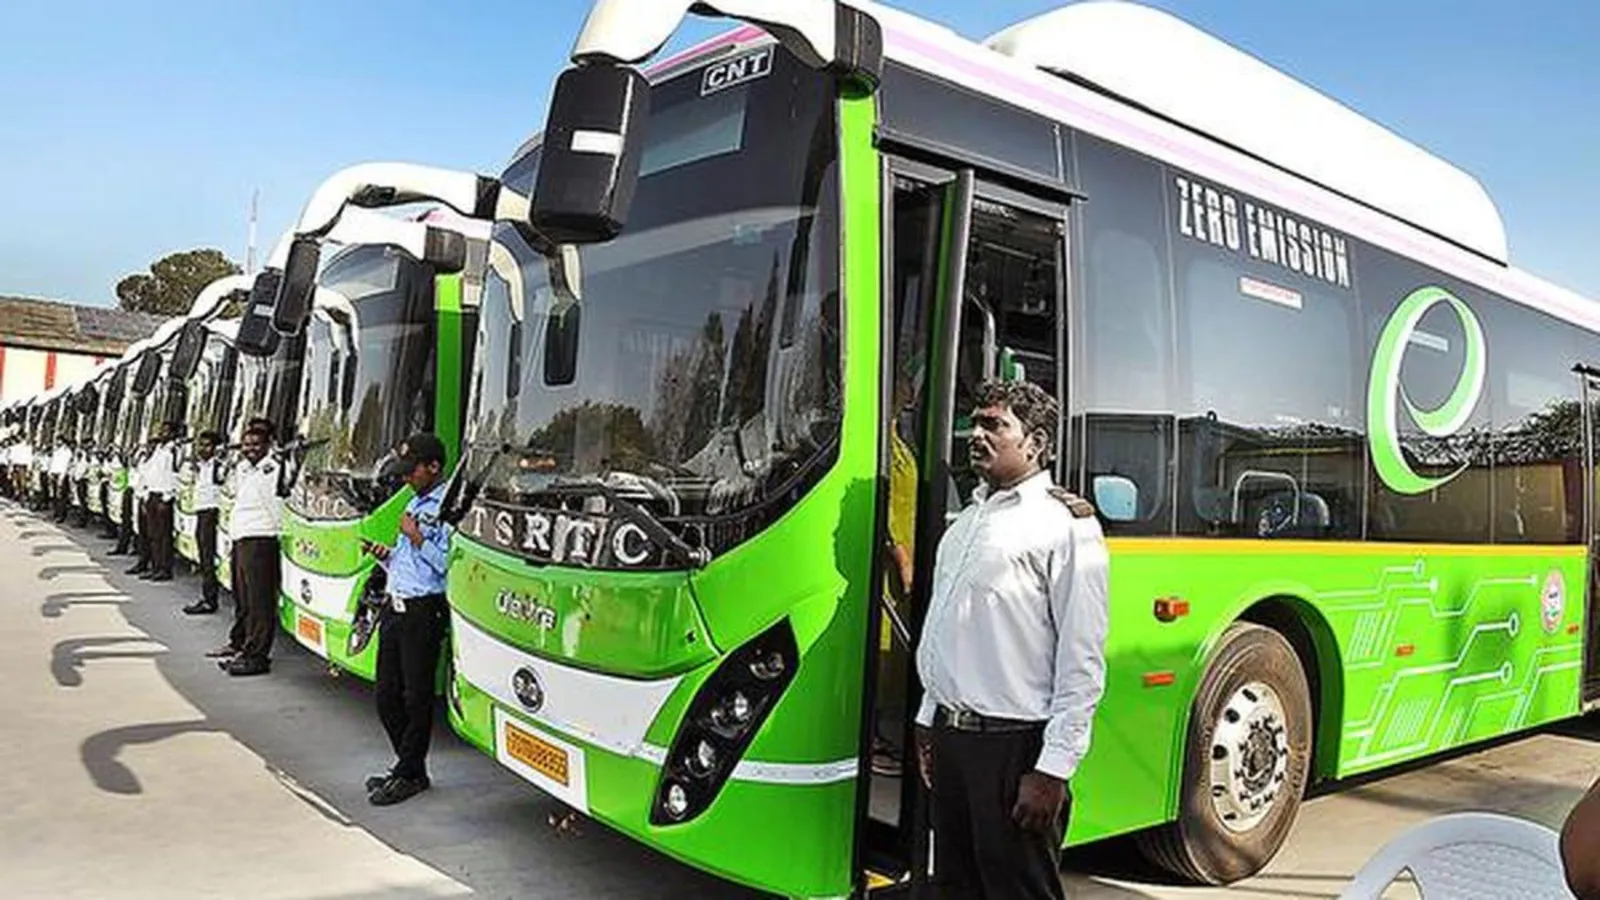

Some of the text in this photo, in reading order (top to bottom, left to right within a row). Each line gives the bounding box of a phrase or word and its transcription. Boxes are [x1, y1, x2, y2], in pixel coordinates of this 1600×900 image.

[708, 52, 768, 87] CNT
[1175, 177, 1351, 288] ZERO EMISSION
